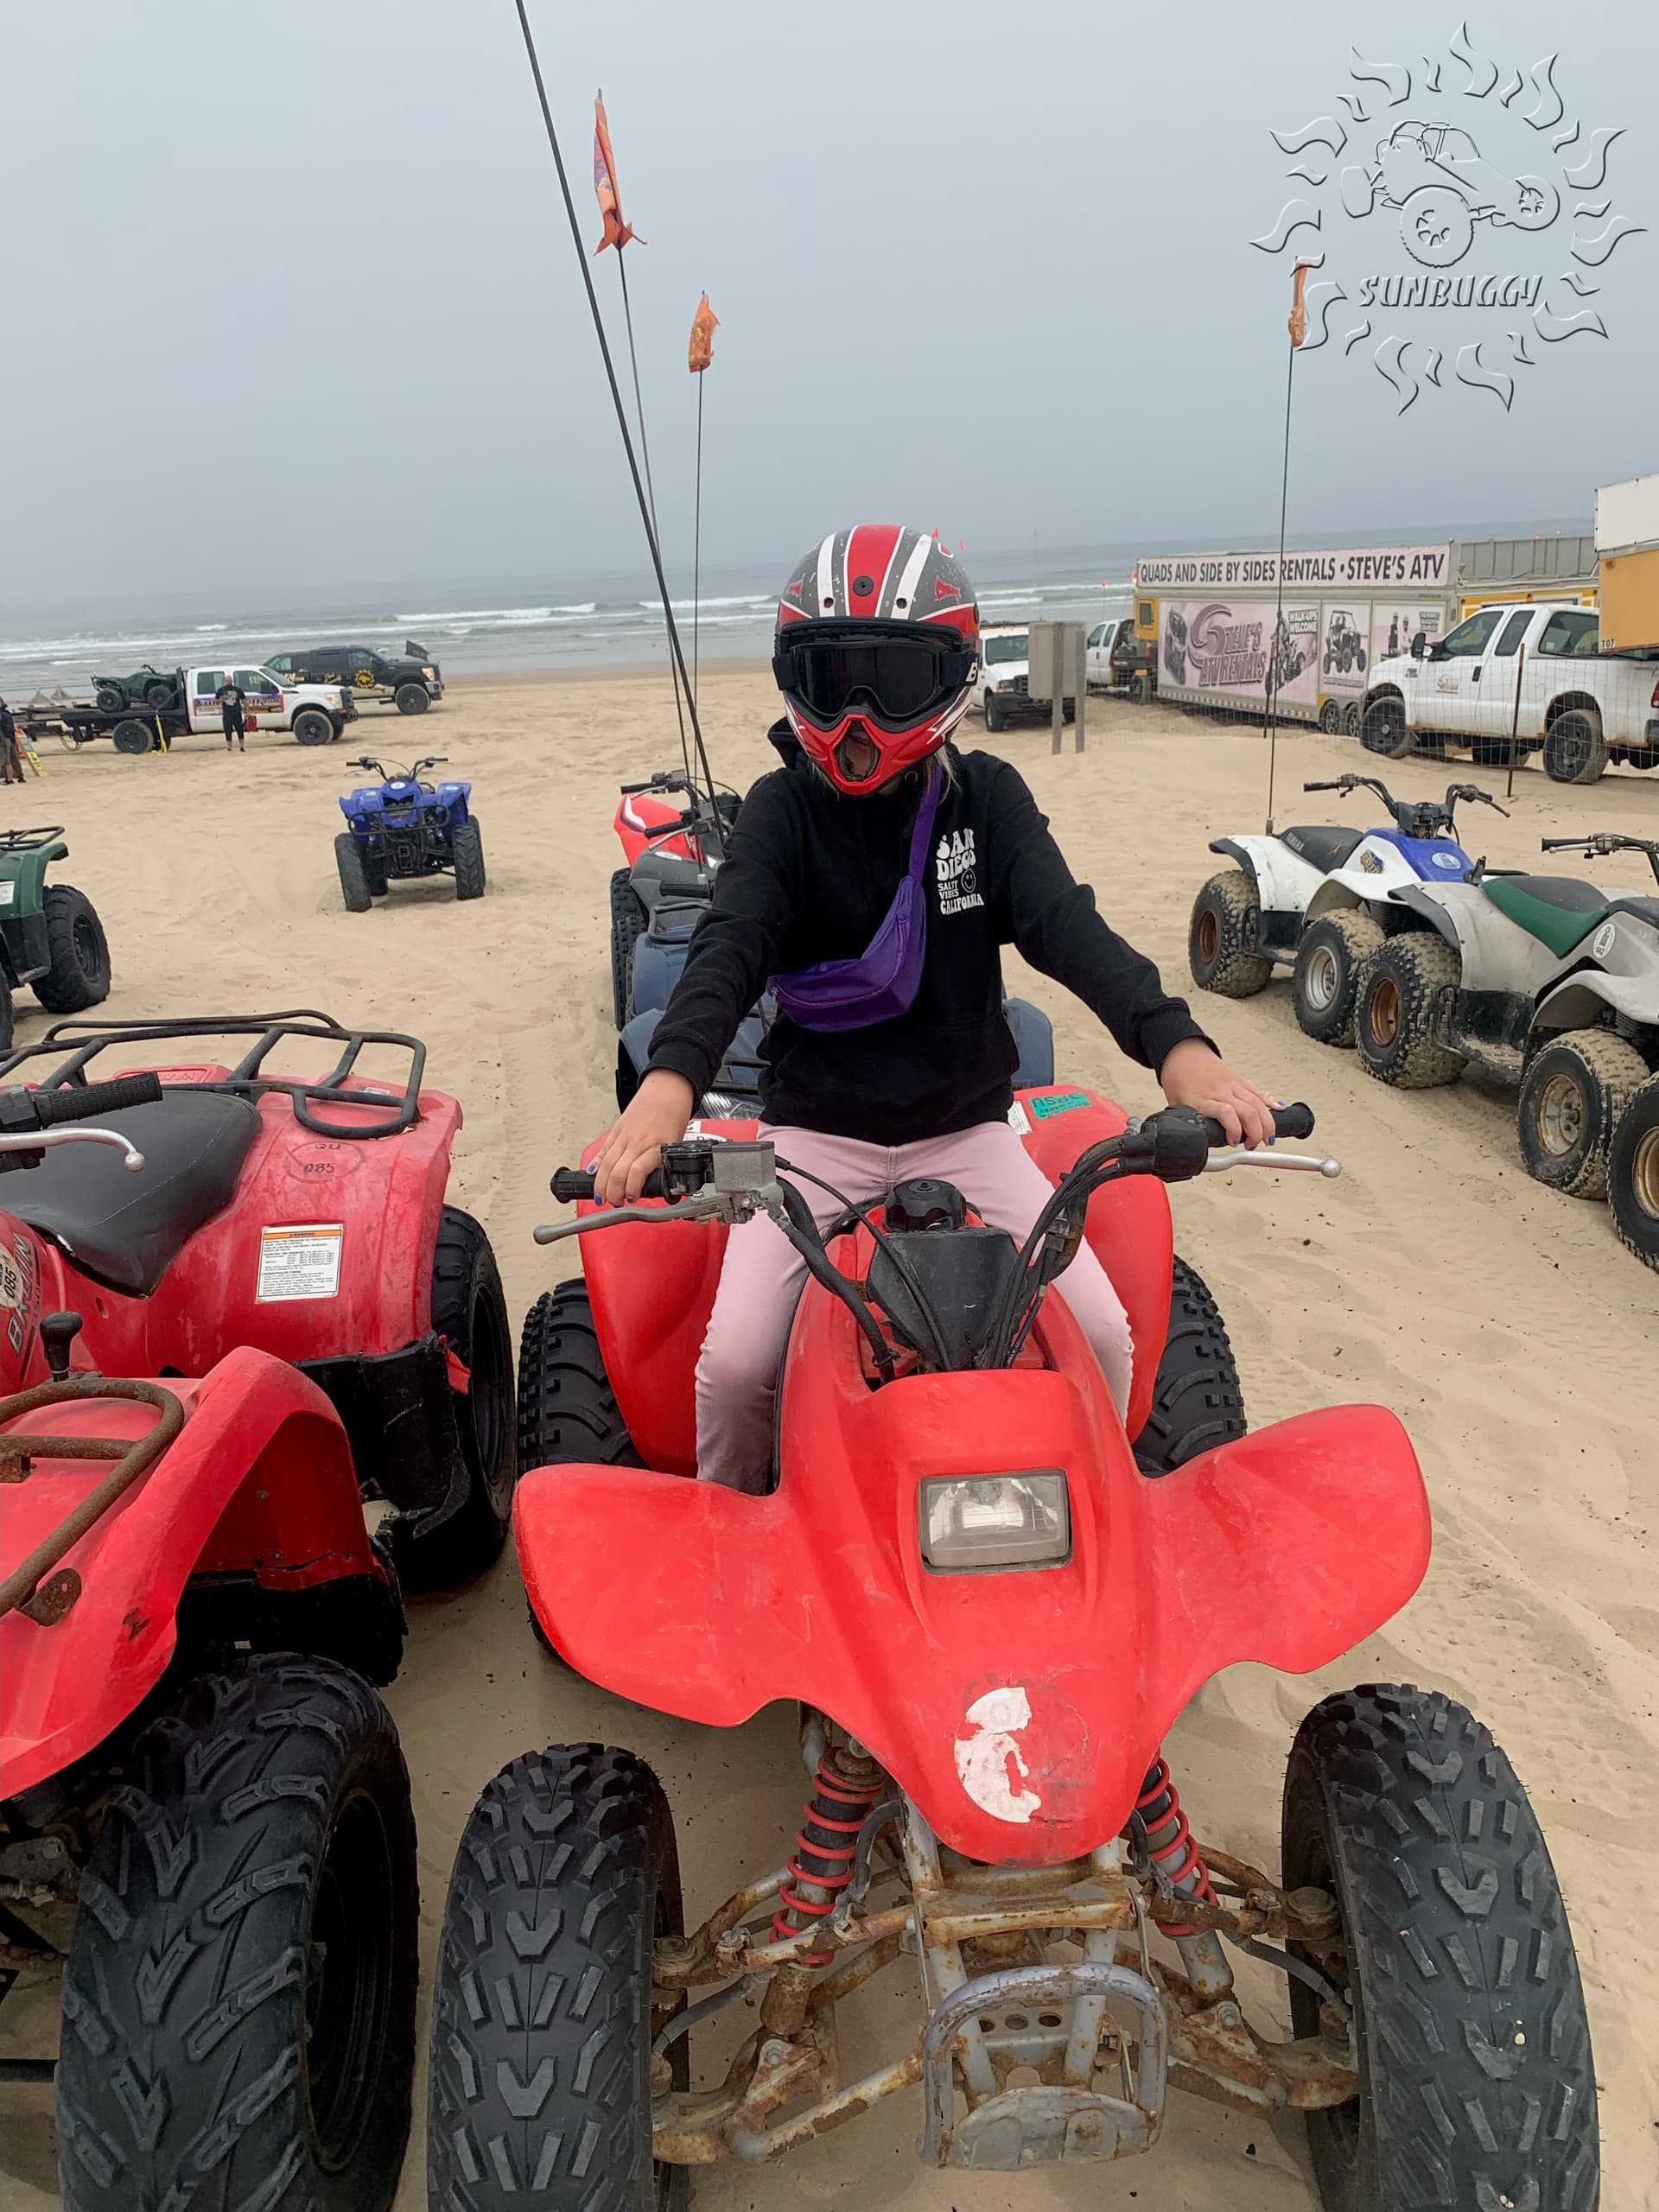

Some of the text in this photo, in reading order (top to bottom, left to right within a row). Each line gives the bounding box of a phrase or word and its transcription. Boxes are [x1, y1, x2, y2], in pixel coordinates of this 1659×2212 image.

[1141, 553, 1446, 583] QUADS AND SIDE BY SIDES RENTALS STEVE'S ATV
[1288, 621, 1317, 633] WELCOME
[1198, 651, 1267, 687] ATV RENTALS
[936, 827, 975, 859] SAN
[936, 849, 976, 881] DIEGO
[940, 893, 985, 915] CALIFORNIA
[303, 1162, 335, 1173] 085
[3, 1266, 16, 1299] 085
